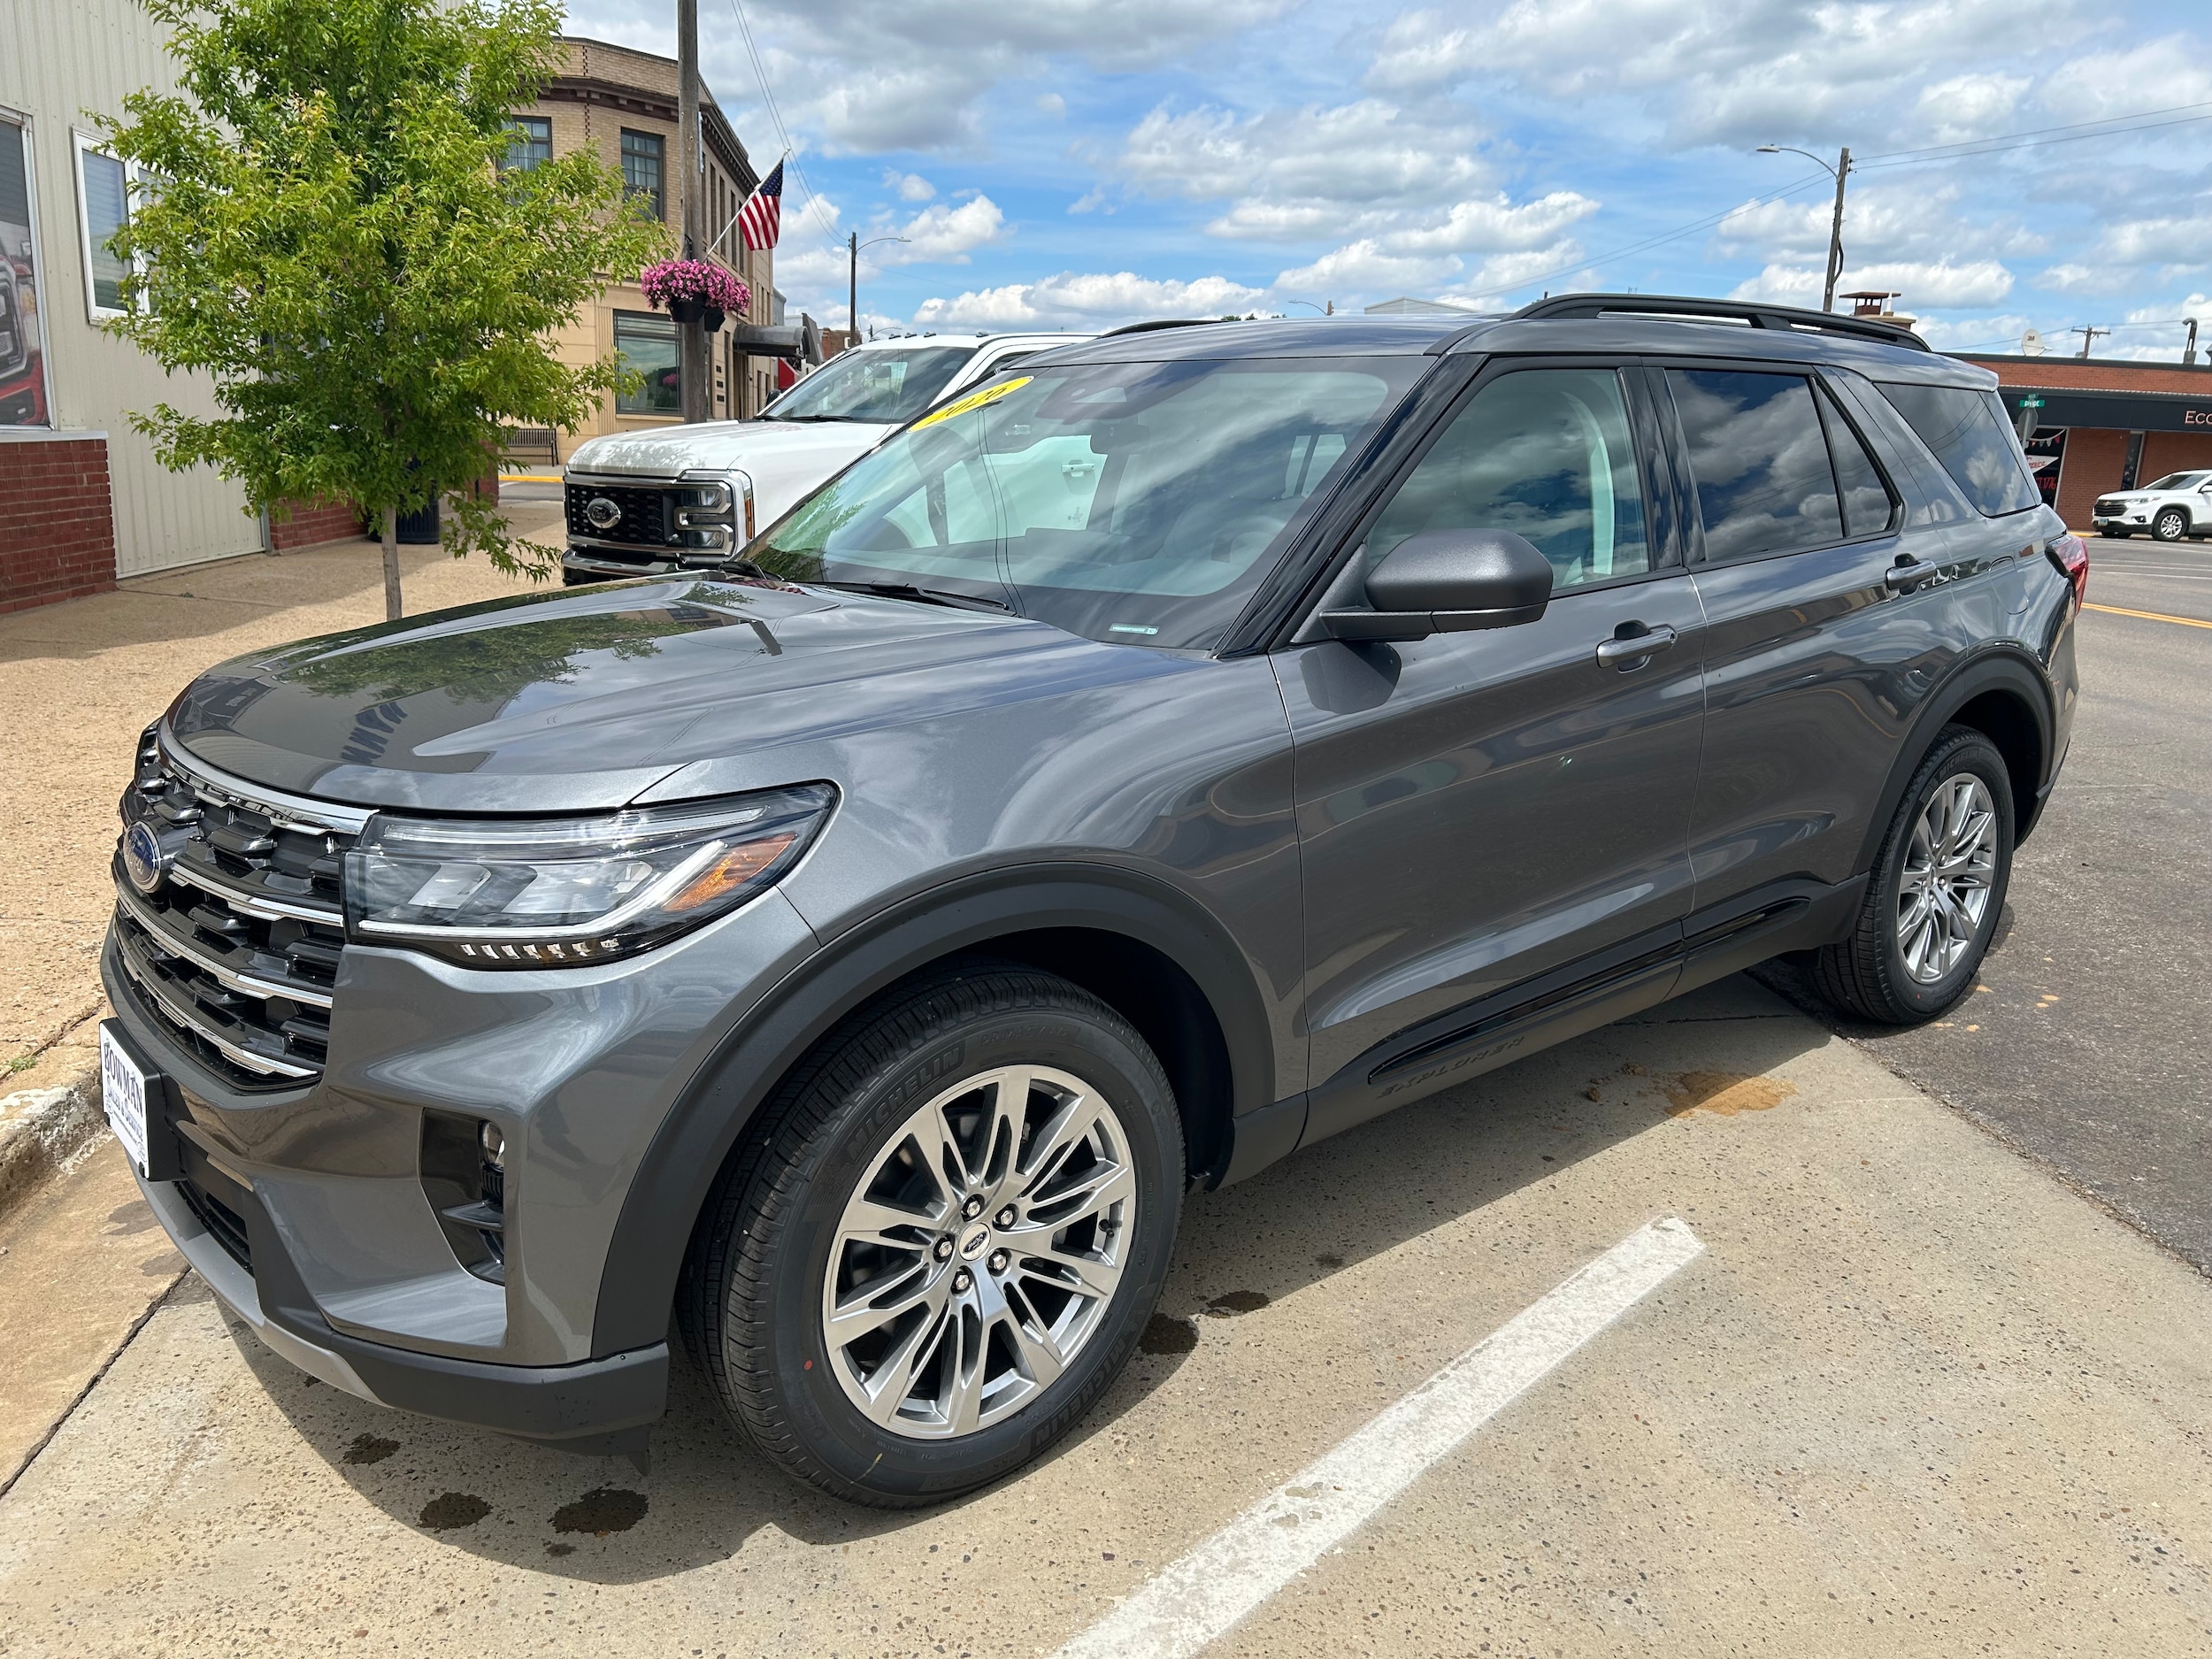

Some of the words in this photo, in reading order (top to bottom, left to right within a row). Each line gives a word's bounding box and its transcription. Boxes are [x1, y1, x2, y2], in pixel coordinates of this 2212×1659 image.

[104, 1044, 143, 1118] BOWMAN
[847, 1047, 961, 1160] MICHELIN
[1376, 1037, 1524, 1099] EXPLORER
[1035, 1339, 1126, 1447] MICHELIN
